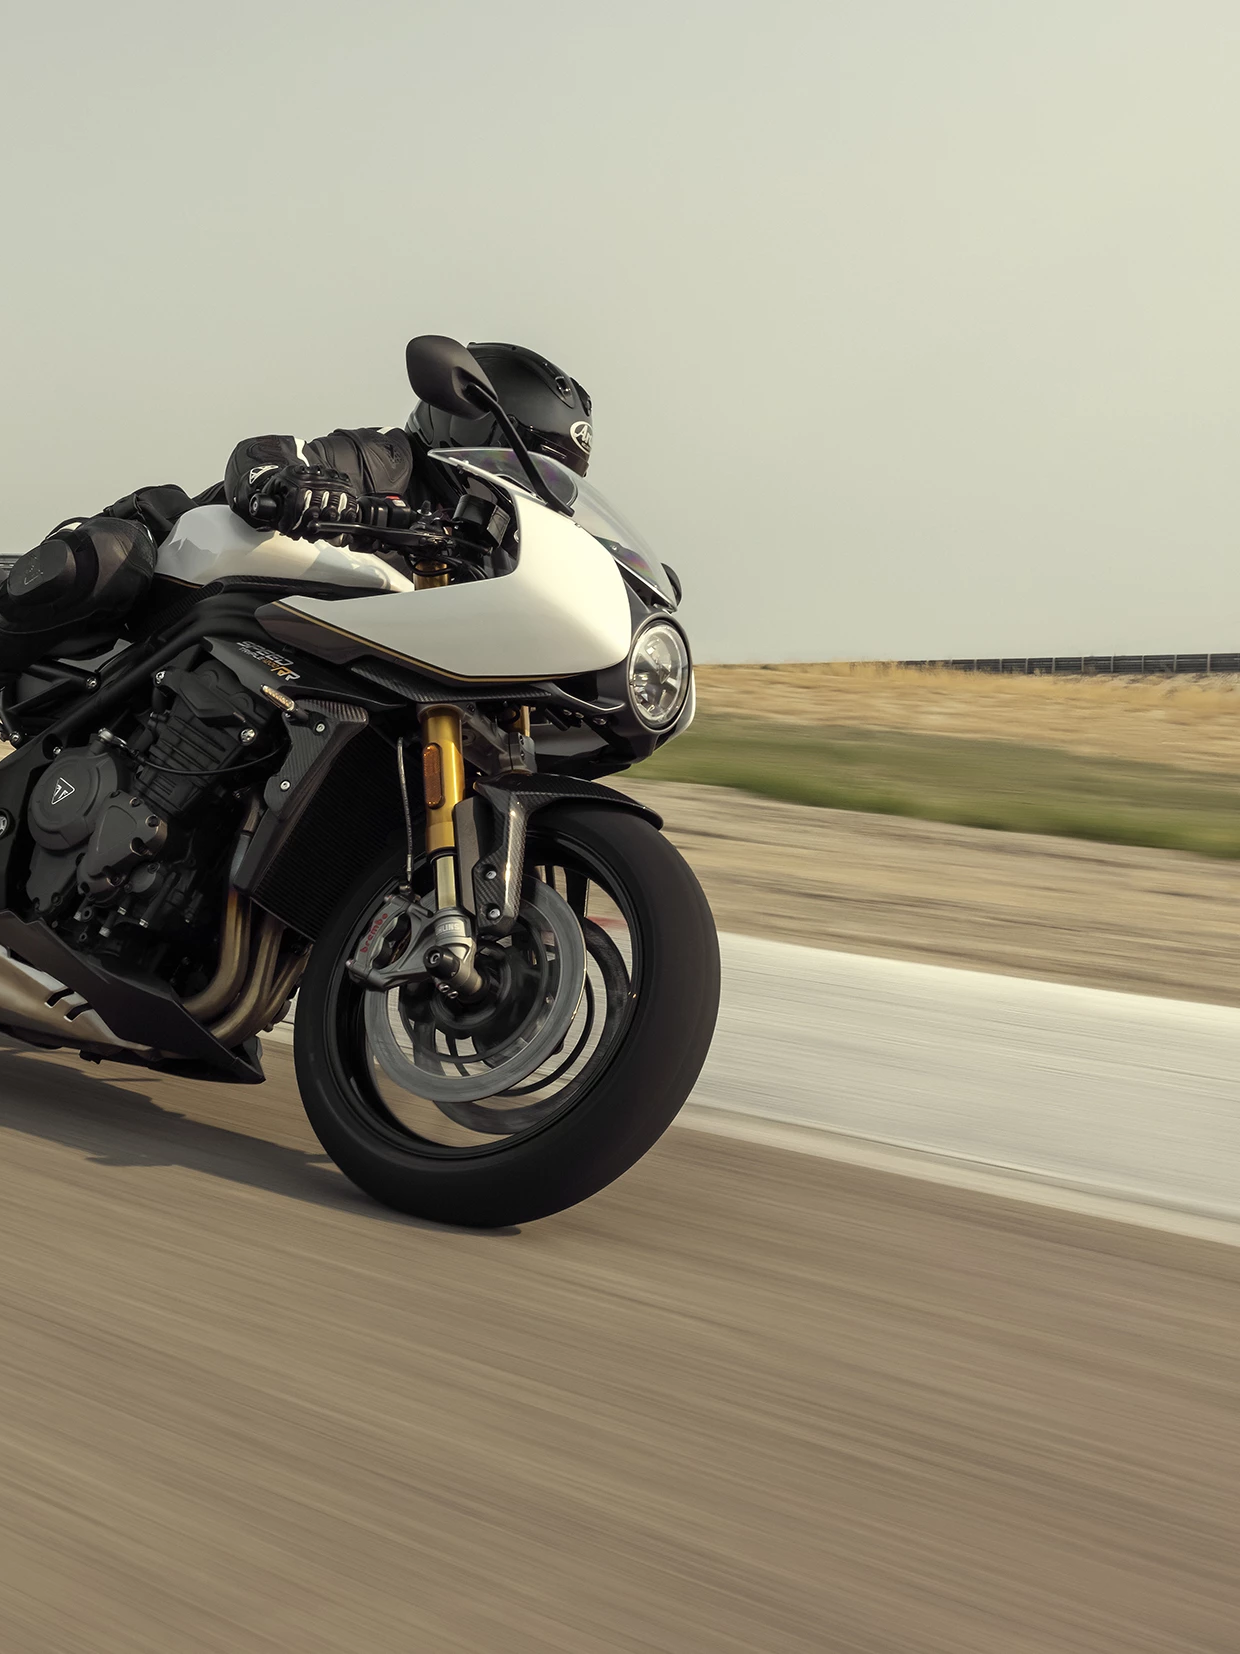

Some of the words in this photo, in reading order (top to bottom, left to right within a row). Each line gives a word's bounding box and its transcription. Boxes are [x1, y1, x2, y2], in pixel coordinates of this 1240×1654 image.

[236, 640, 294, 666] SPEED
[271, 665, 301, 681] RR
[360, 913, 388, 953] brembo
